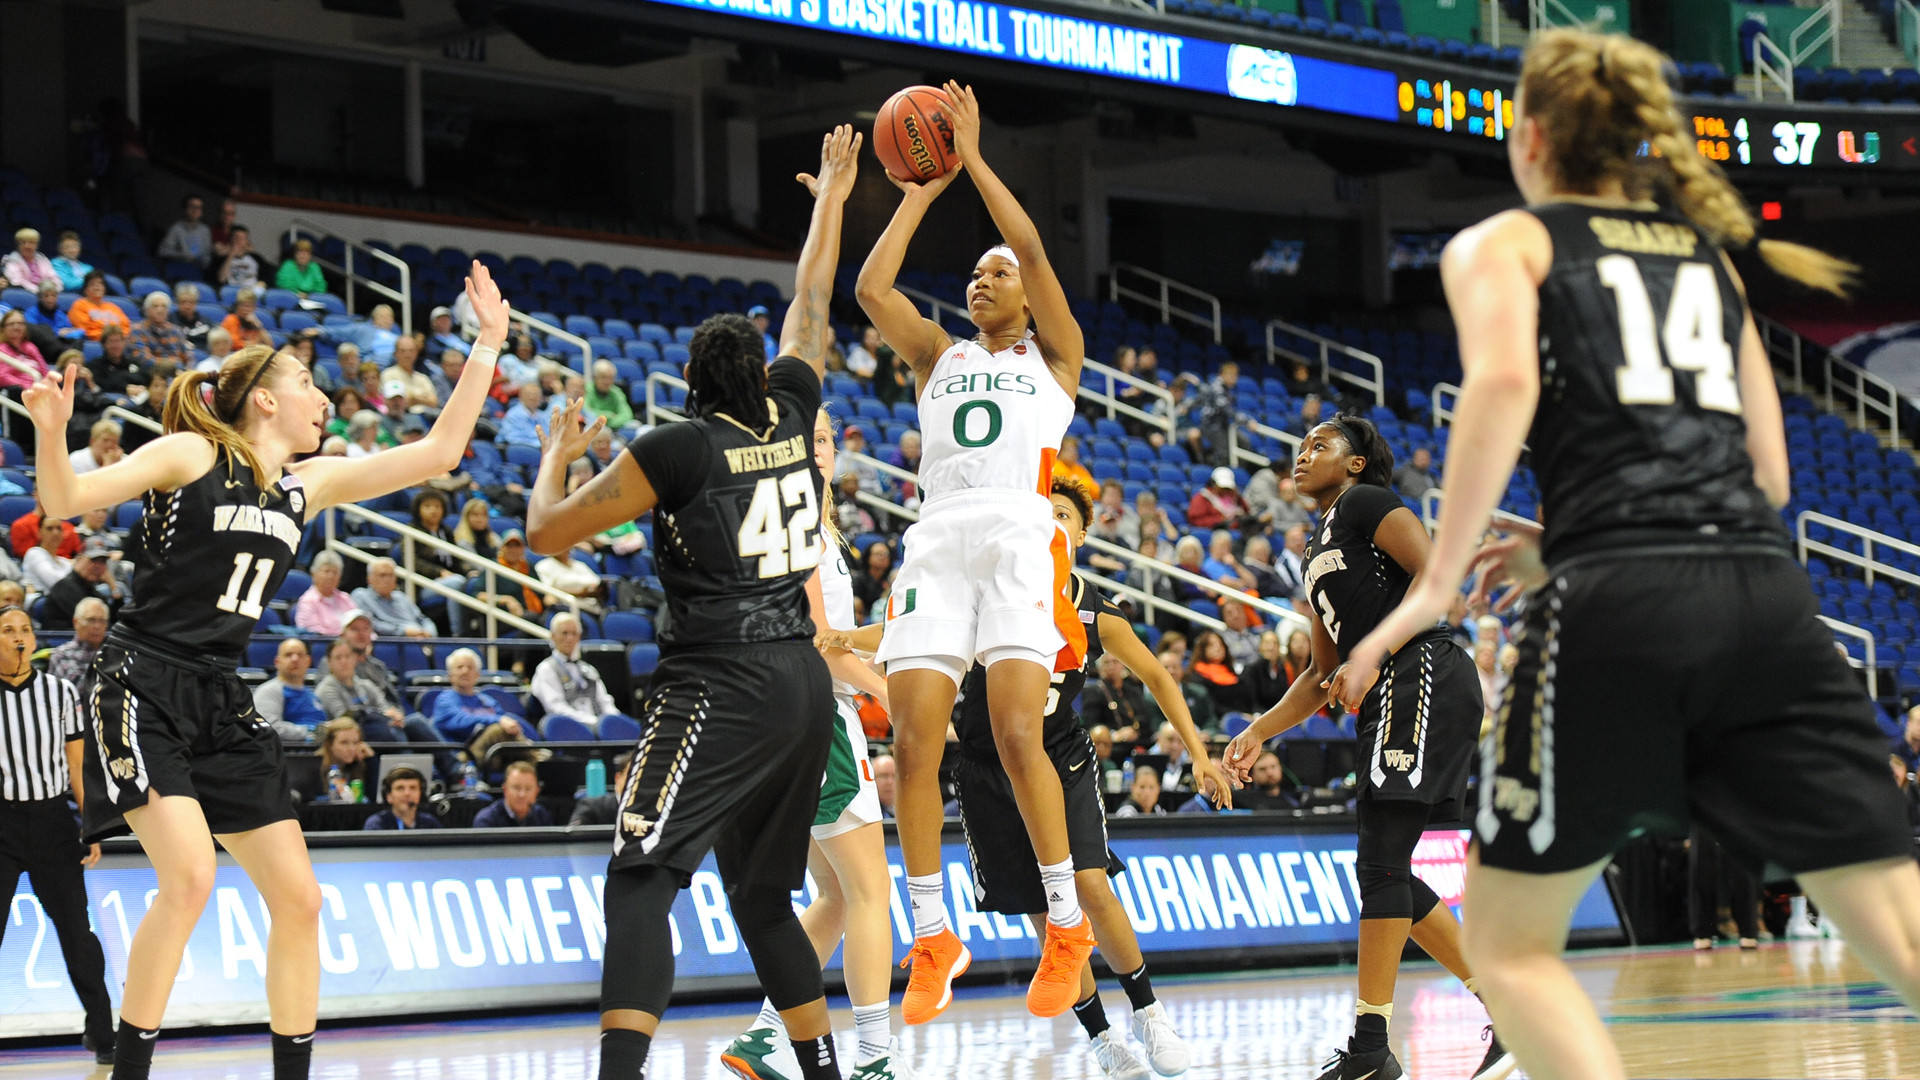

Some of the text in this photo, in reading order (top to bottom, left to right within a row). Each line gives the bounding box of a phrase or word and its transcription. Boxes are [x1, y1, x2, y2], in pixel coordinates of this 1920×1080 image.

[828, 0, 1183, 82] BASKETBALL TOURNAMENT
[1240, 63, 1286, 86] ACC
[904, 114, 938, 177] Wilson
[1693, 116, 1730, 138] TOL
[1772, 122, 1821, 165] 37
[1837, 131, 1880, 163] U
[1738, 141, 1750, 165] 1
[1588, 216, 1698, 257] SHARP
[1596, 254, 1742, 414] 14
[953, 400, 1002, 447] 0
[738, 467, 821, 579] 42
[216, 552, 275, 620] 11
[1317, 589, 1341, 645] 2
[109, 757, 136, 780] WF
[1384, 749, 1415, 771] WF
[622, 811, 655, 837] WF
[217, 882, 360, 980] AC
[1107, 849, 1363, 934] URNAMENT
